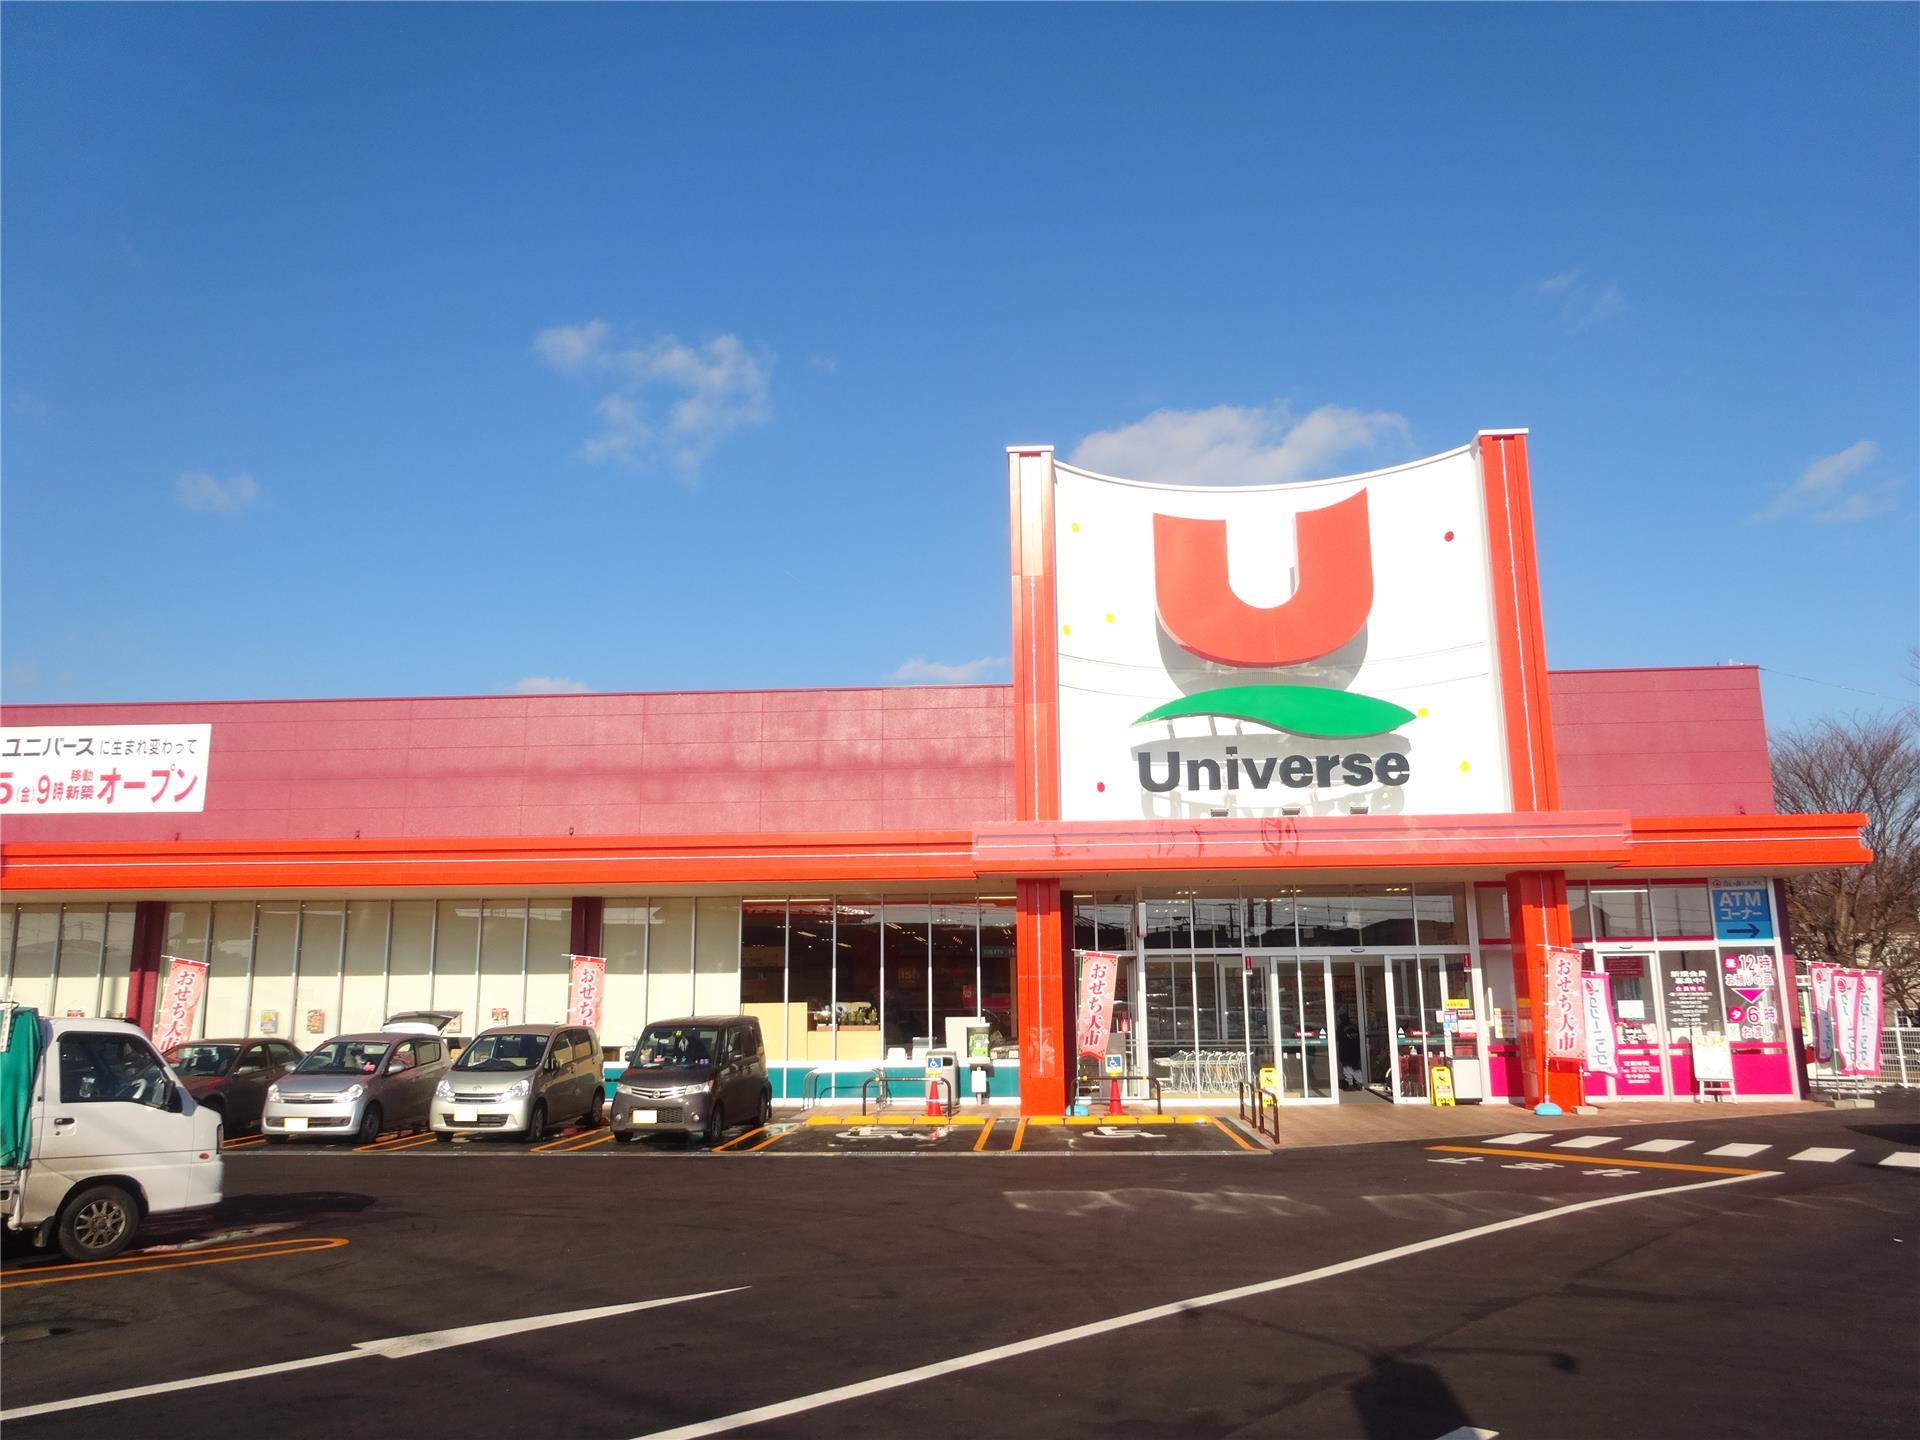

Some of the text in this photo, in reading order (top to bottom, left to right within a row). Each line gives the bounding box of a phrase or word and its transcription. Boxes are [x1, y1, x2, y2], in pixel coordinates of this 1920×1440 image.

[1152, 487, 1374, 668] U
[97, 763, 198, 804] オープン
[1138, 746, 1410, 792] Universe
[1720, 892, 1761, 907] ATM
[1720, 907, 1763, 920] コーナー
